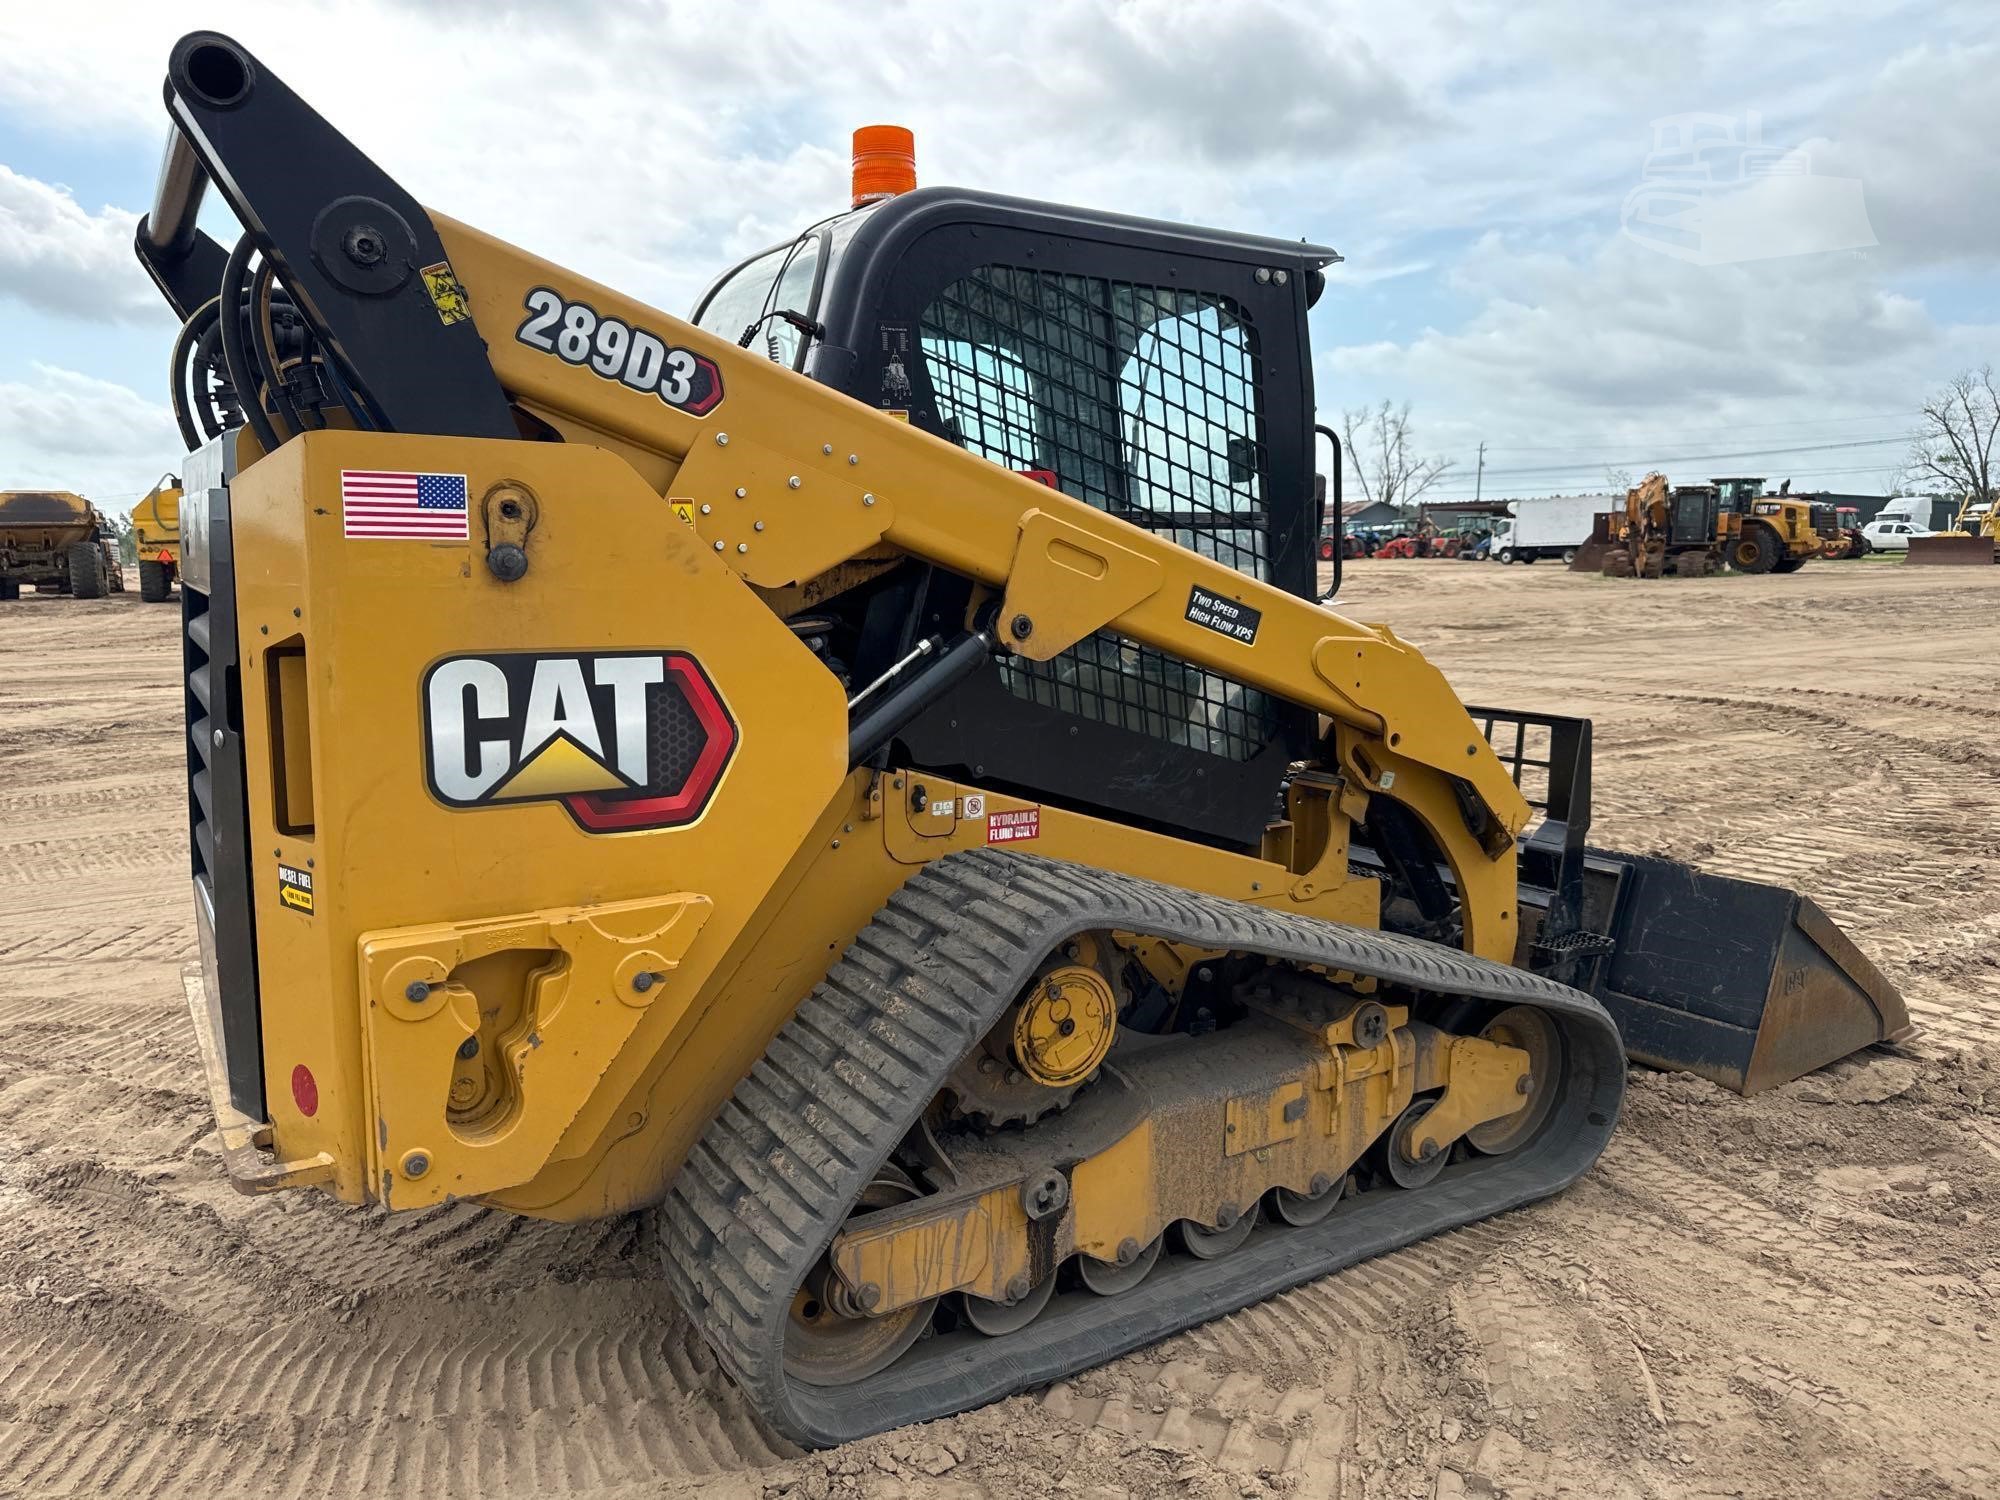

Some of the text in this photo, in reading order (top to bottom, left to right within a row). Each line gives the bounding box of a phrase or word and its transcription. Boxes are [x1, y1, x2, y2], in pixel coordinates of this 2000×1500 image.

[519, 289, 696, 404] 289D3
[1192, 591, 1239, 618] TWO SPEED
[1189, 606, 1254, 640] HIGH FLOW XPS
[429, 656, 664, 801] CAT
[990, 811, 1037, 827] HYDRAULIC
[989, 825, 1038, 841] FLUID ONLY
[279, 867, 312, 889] DIESEL FUEL
